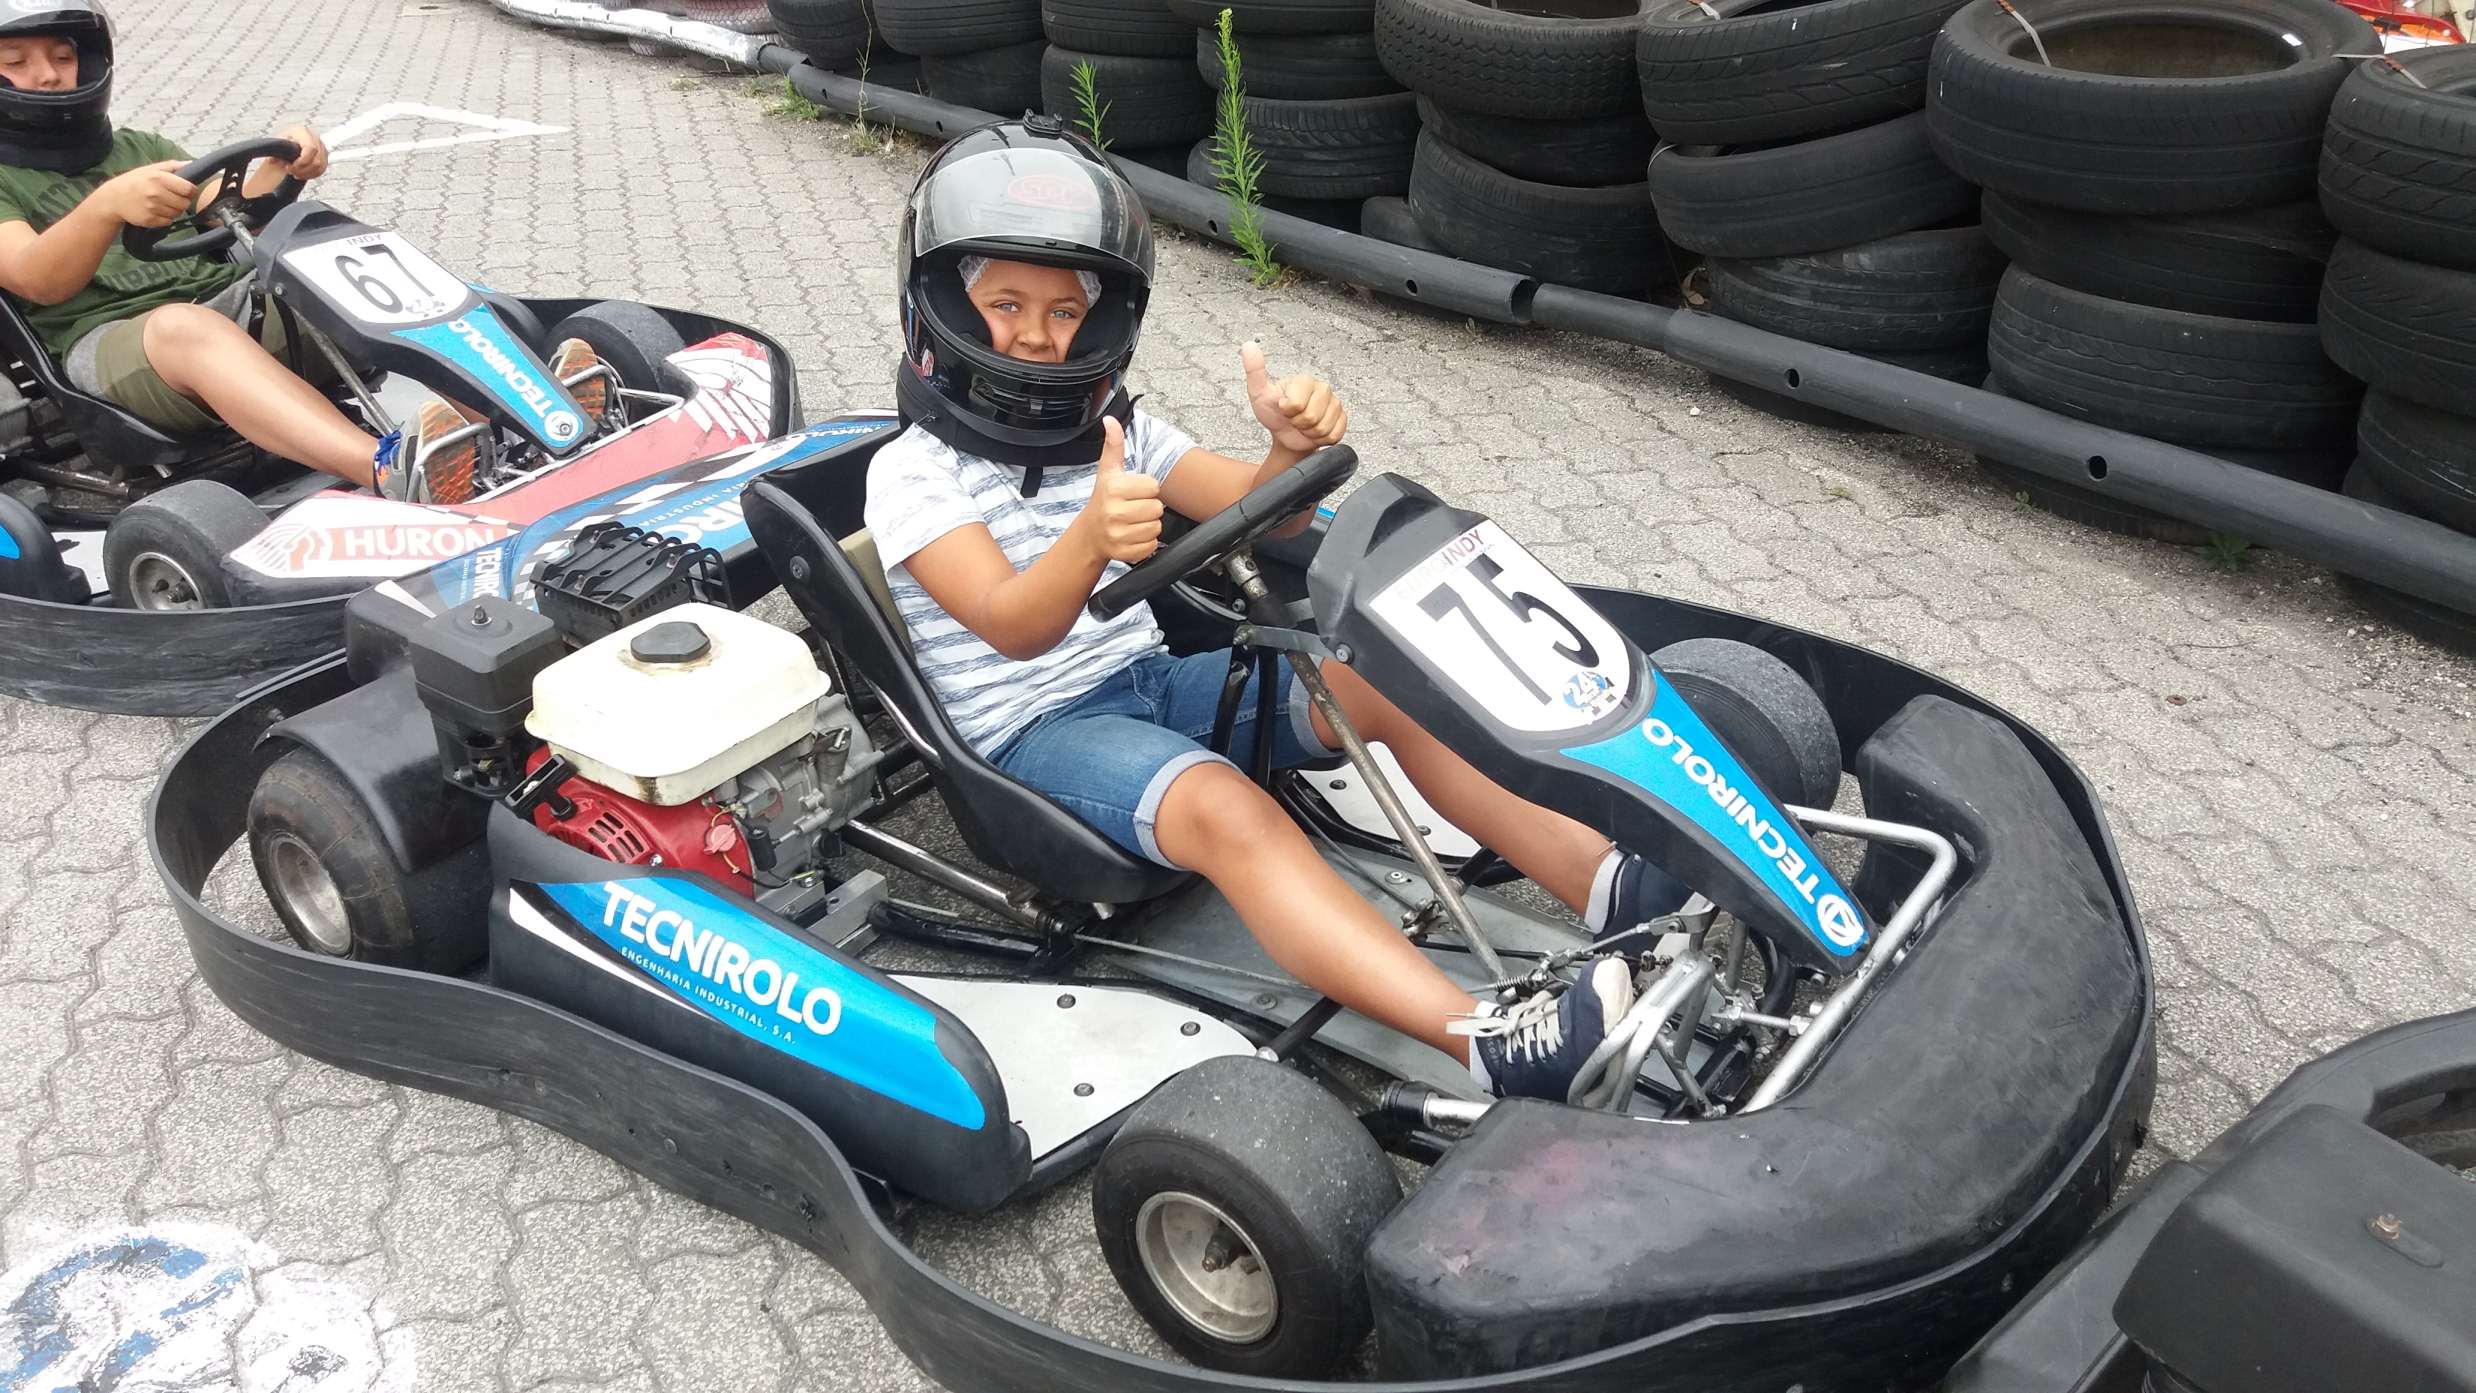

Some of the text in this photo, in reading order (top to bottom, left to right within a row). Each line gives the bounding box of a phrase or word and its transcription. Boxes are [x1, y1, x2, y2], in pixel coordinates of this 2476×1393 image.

[346, 233, 383, 246] INDY
[335, 243, 435, 314] 67
[448, 319, 553, 418] TECNIROLO
[344, 526, 495, 557] HURON
[639, 493, 720, 527] INDUSTRIA
[1415, 553, 1600, 706] 75
[1641, 717, 1820, 904] TECNIROLO
[602, 880, 842, 1036] TECNIROLO
[621, 946, 691, 990] ENGENHARIA
